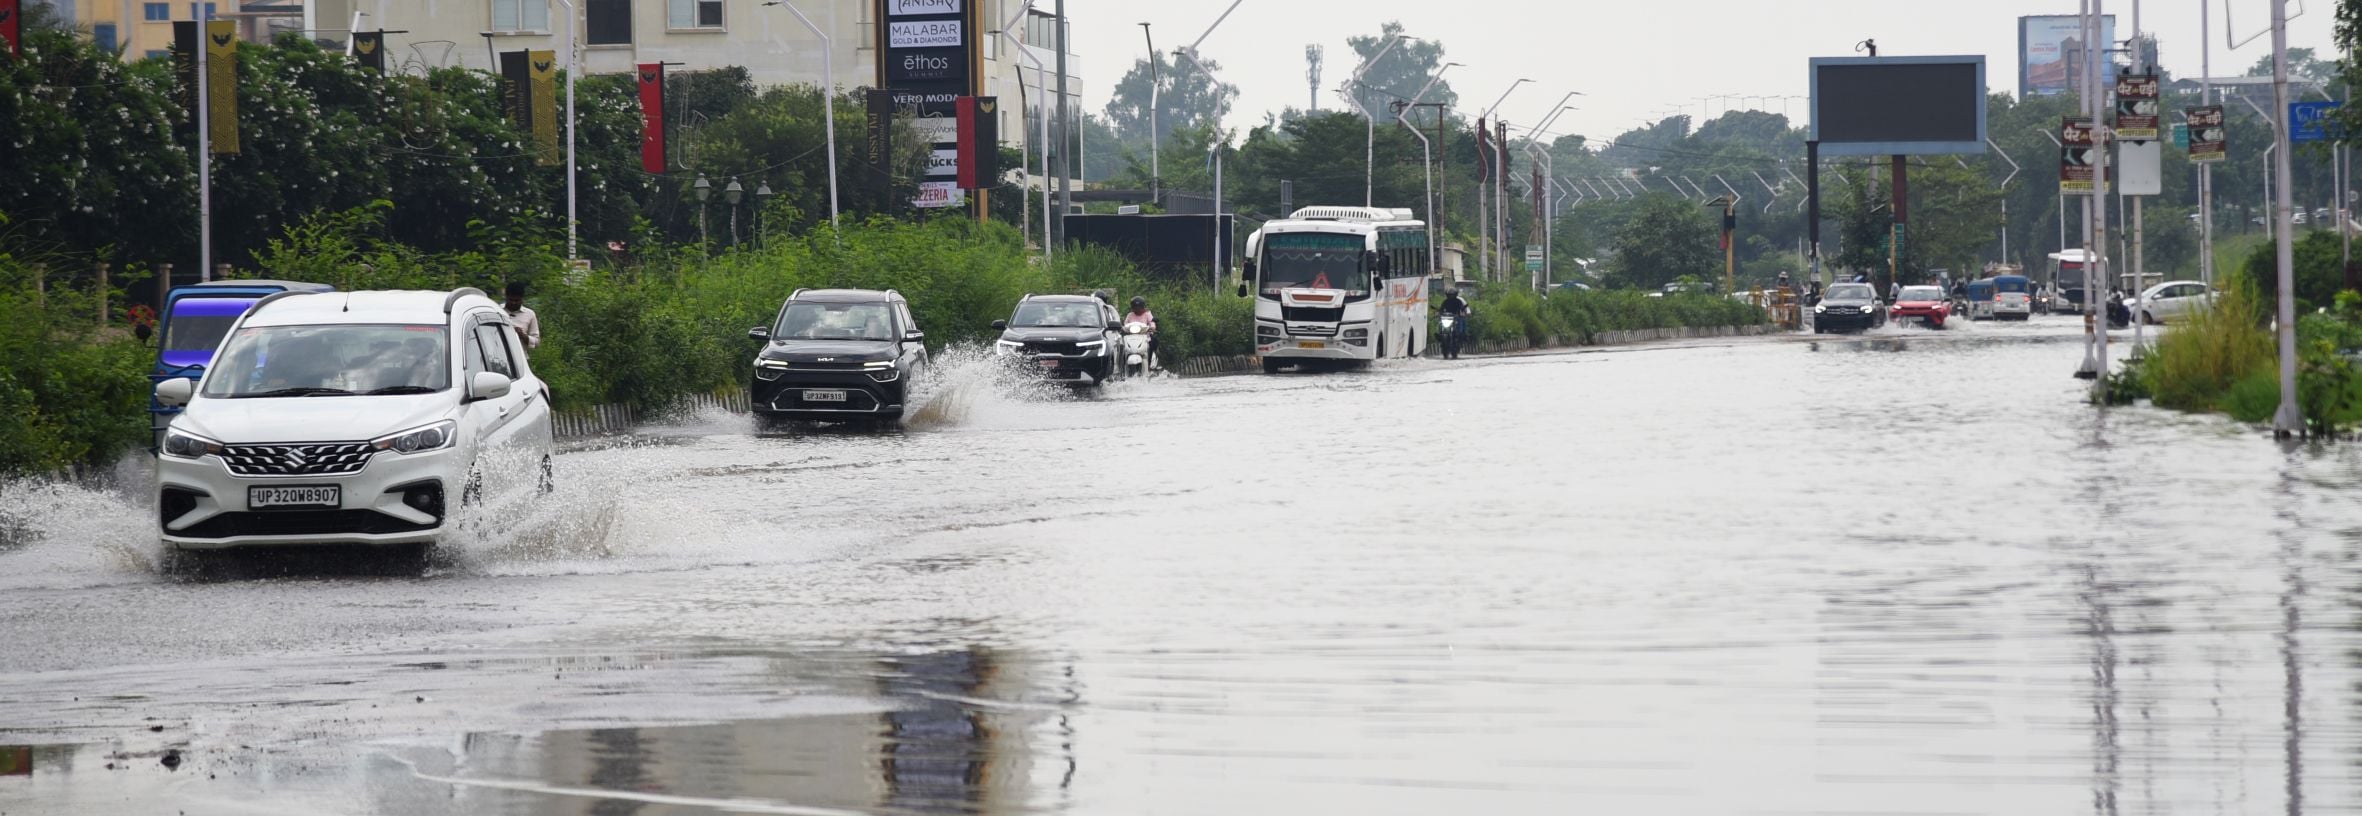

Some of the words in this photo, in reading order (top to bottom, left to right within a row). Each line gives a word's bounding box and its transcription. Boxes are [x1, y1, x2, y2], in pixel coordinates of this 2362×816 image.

[892, 24, 957, 36] MALABAR
[904, 54, 948, 70] ēthos
[893, 95, 923, 103] VERO
